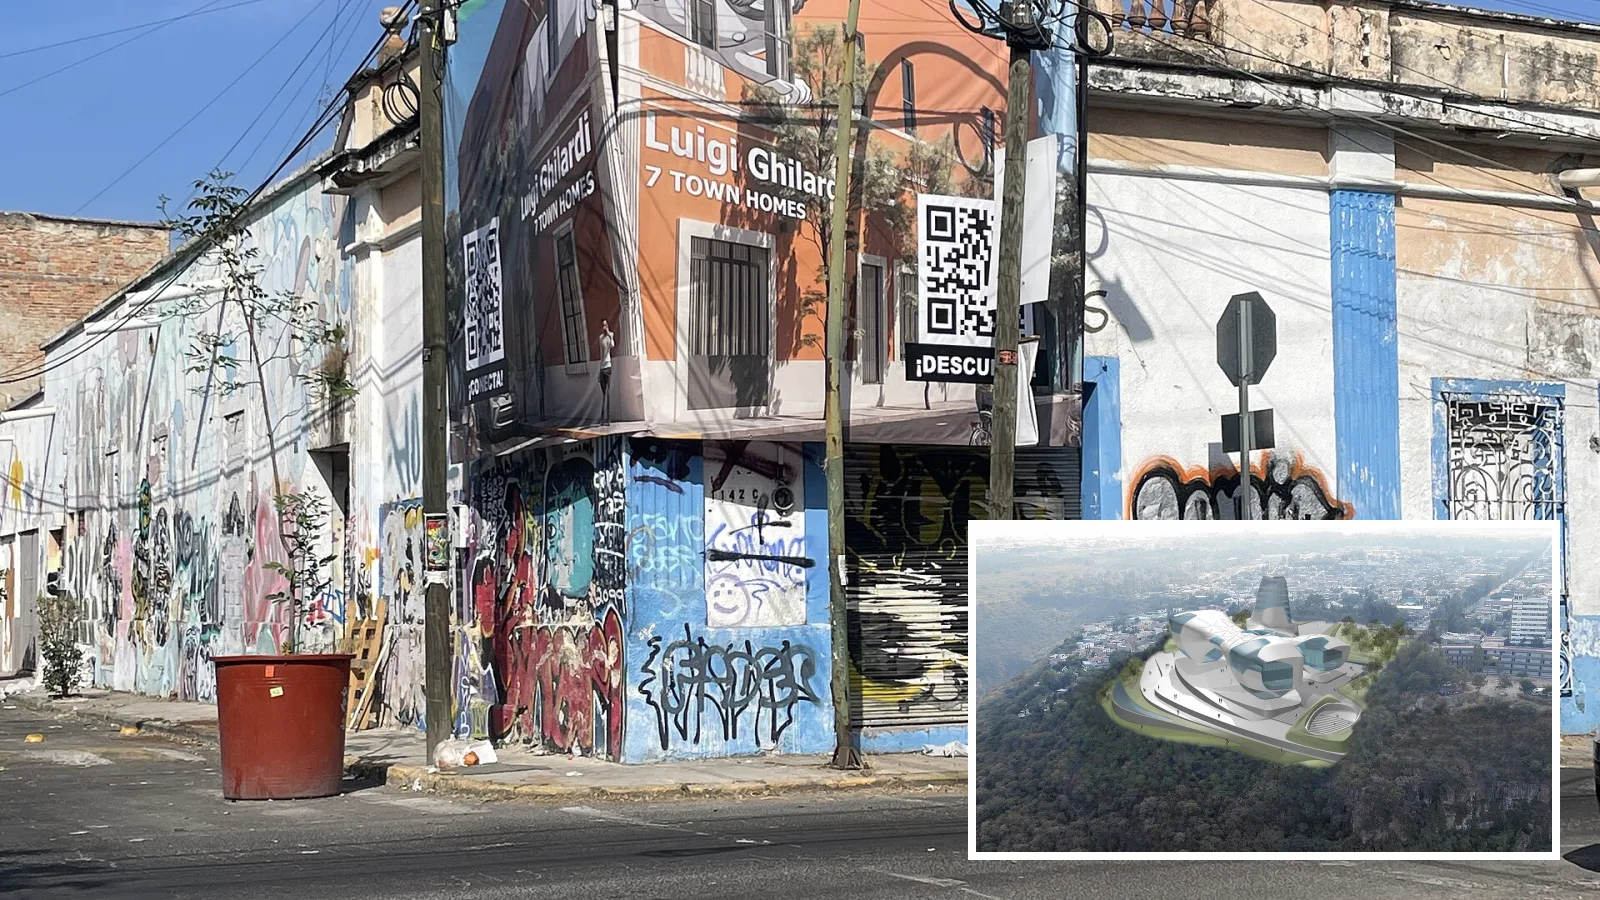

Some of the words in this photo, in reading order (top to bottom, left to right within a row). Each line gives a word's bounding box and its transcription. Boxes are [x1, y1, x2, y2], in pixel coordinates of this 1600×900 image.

[521, 173, 539, 221] Luigi
[540, 110, 591, 197] Ghilardi
[645, 111, 737, 176] Luigi
[538, 199, 559, 232] TOWN
[559, 170, 595, 215] HOMES
[645, 165, 662, 187] 7
[669, 170, 740, 205] TOWN
[746, 189, 806, 220] HOMES
